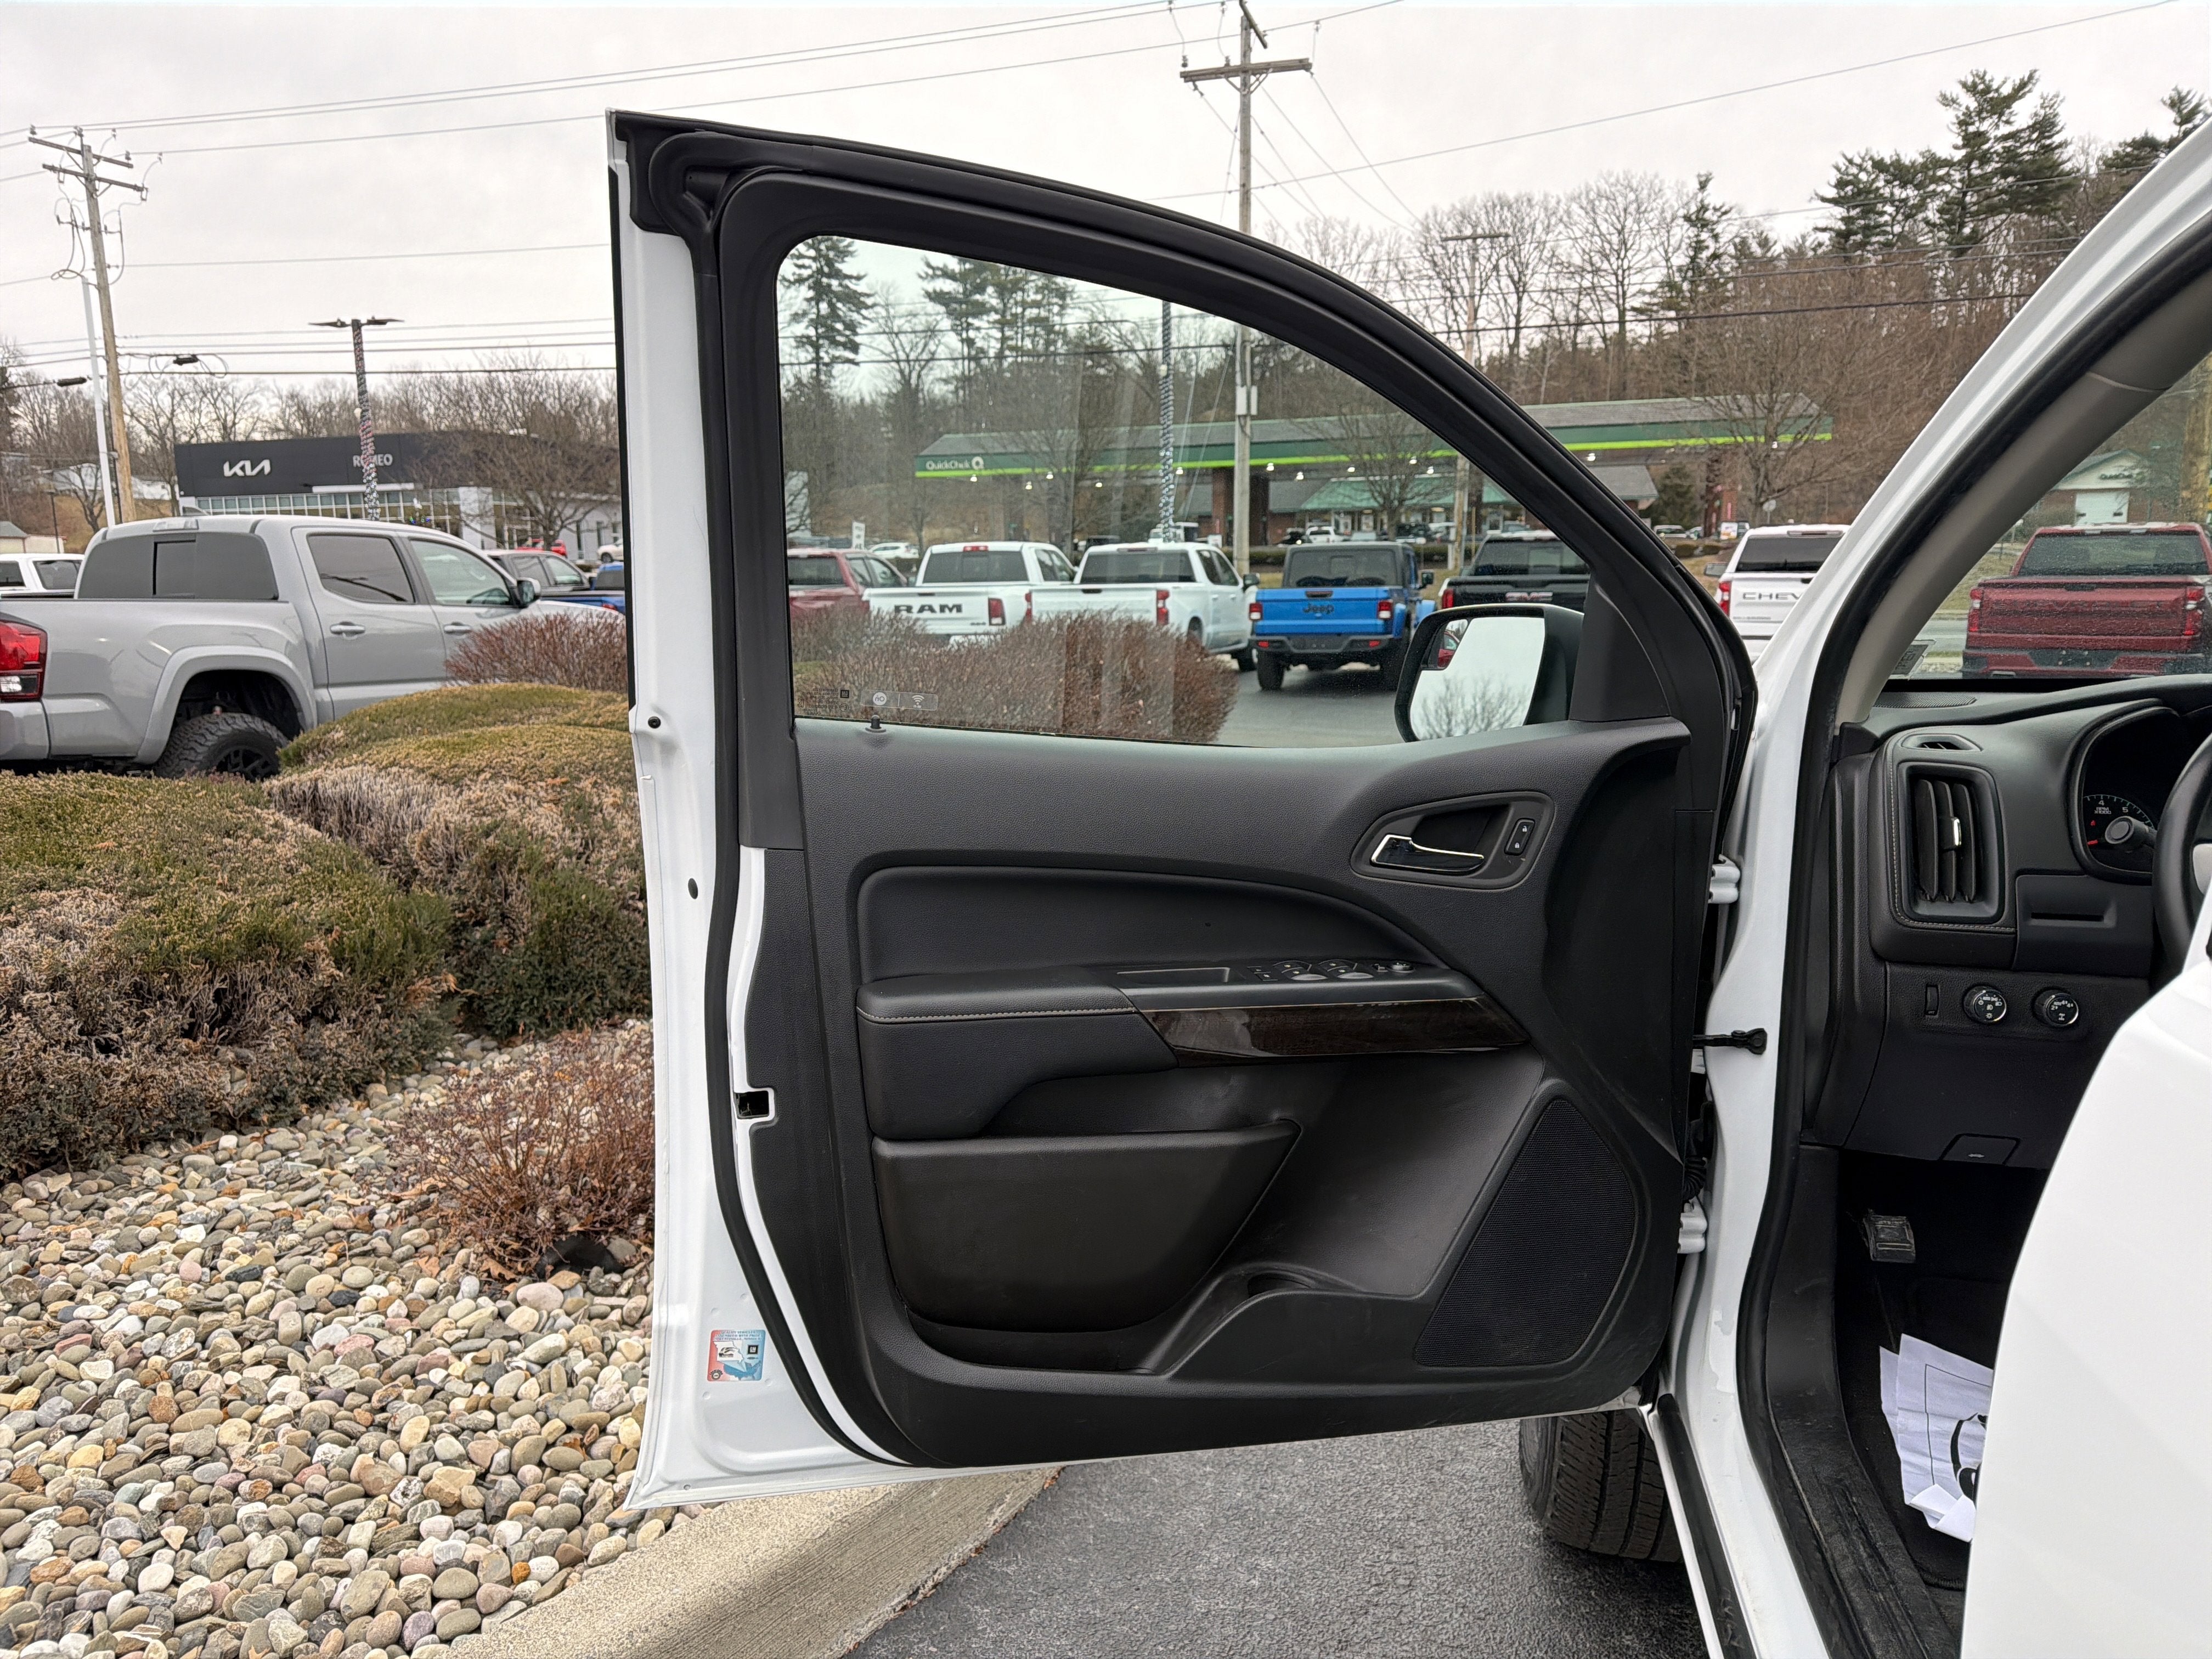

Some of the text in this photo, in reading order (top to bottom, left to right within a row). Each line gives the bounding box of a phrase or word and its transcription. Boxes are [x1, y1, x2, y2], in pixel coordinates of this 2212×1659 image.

[223, 459, 270, 476] KIA
[1505, 592, 1553, 601] GMC
[894, 604, 963, 613] RAM
[1304, 603, 1335, 614] Jeep
